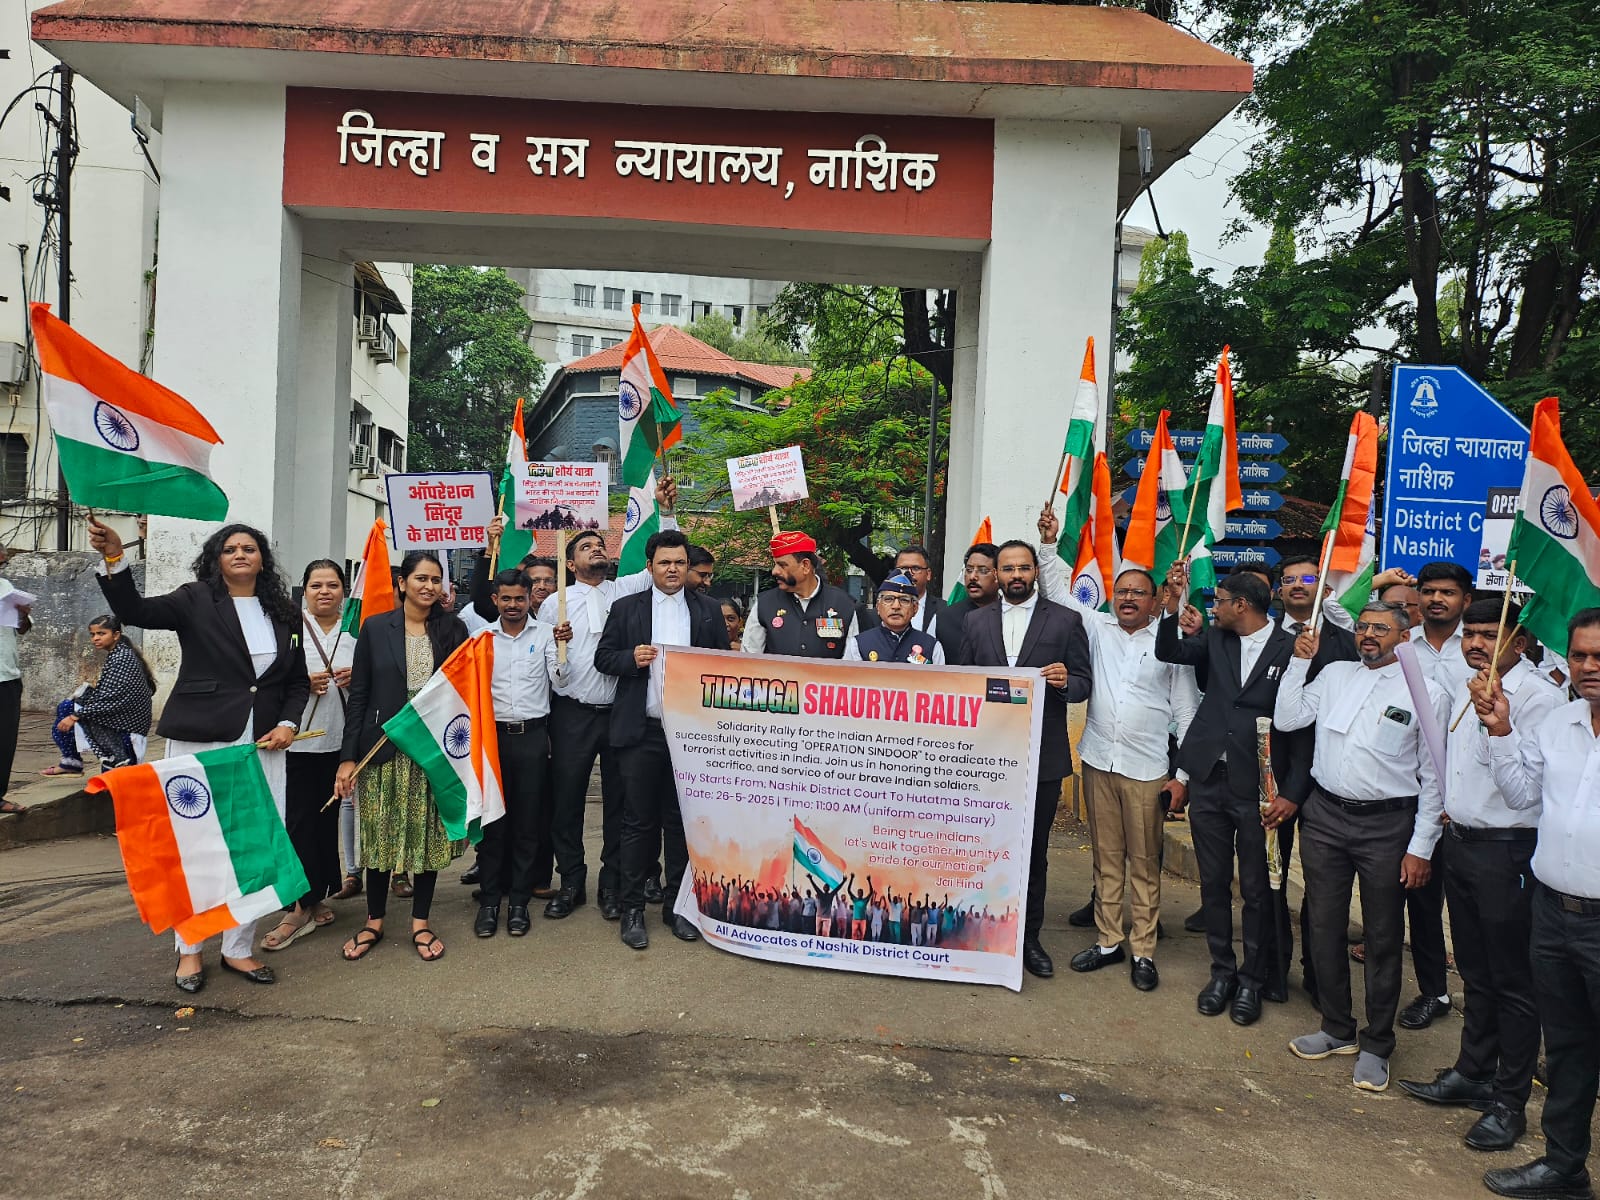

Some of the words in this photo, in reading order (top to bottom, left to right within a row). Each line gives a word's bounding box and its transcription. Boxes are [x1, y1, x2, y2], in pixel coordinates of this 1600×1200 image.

[337, 109, 445, 176] जिल्हा
[470, 133, 500, 173] व
[526, 136, 589, 178] सत्र
[615, 140, 795, 199] न्यायालय,
[808, 134, 939, 192] नाशिक
[1241, 434, 1274, 449] नाशिक
[1401, 427, 1451, 459] जिल्हा
[1455, 437, 1526, 460] न्यायालय
[1398, 462, 1455, 491] नाशिक
[408, 481, 475, 500] ऑपरेशन
[1246, 491, 1271, 506] नाशिक
[424, 502, 463, 526] सिंदूर
[1395, 508, 1462, 531] District
[406, 524, 422, 542] के
[424, 527, 457, 542] साथ
[1393, 534, 1455, 558] Nashik
[1485, 572, 1504, 586] सेना
[701, 674, 799, 714] TIRANGA
[803, 683, 909, 722] SHAURYA
[914, 692, 983, 728] RALLY
[716, 720, 767, 735] Solidarity
[770, 725, 796, 738] Rally
[798, 726, 814, 737] for
[817, 728, 834, 740] the
[837, 730, 873, 743] Indian
[876, 733, 914, 746] Armed
[917, 737, 955, 750] Forces
[957, 740, 974, 751] for
[675, 730, 741, 747] successfully
[743, 738, 798, 751] executing
[925, 752, 936, 761] to
[938, 753, 996, 766] eradicate
[998, 757, 1019, 768] the
[683, 743, 726, 756] terrorist
[728, 748, 778, 761] activities
[780, 751, 790, 762] in
[825, 756, 848, 768] Join
[850, 759, 864, 768] us
[866, 758, 876, 769] in
[879, 760, 931, 777] honoring
[934, 765, 953, 776] the
[757, 763, 778, 774] and
[781, 767, 821, 778] service
[824, 768, 835, 779] of
[837, 771, 856, 781] our
[859, 774, 892, 785] brave
[895, 775, 931, 788] Indian
[933, 779, 981, 792] soldiers.
[699, 773, 732, 785] Starts
[769, 780, 807, 793] Nashik
[810, 783, 851, 798] District
[854, 788, 887, 800] Court
[890, 791, 904, 802] To
[906, 793, 960, 807] Hutatma
[963, 797, 1013, 811] Smarak.
[685, 787, 714, 799] Date:
[716, 790, 775, 805] 26-5-2025
[784, 797, 813, 810] Time:
[816, 800, 840, 812] 11:00
[842, 803, 861, 814] AM
[863, 803, 915, 820] (uniform
[918, 808, 996, 828] compulsary)
[873, 825, 906, 840] Being
[909, 829, 934, 840] true
[844, 837, 868, 848] let's
[870, 839, 897, 851] walk
[900, 842, 951, 856] together
[955, 845, 966, 856] in
[969, 848, 1000, 862] unity
[1001, 849, 1010, 860] &
[869, 854, 900, 867] pride
[902, 855, 920, 867] for
[921, 859, 941, 869] our
[936, 876, 953, 888] Jai
[955, 878, 984, 890] Hind
[715, 924, 729, 936] All
[730, 925, 798, 948] Advocates
[800, 937, 813, 949] of
[815, 938, 859, 954] Nashik
[862, 943, 909, 960] District
[912, 949, 950, 963] Court
